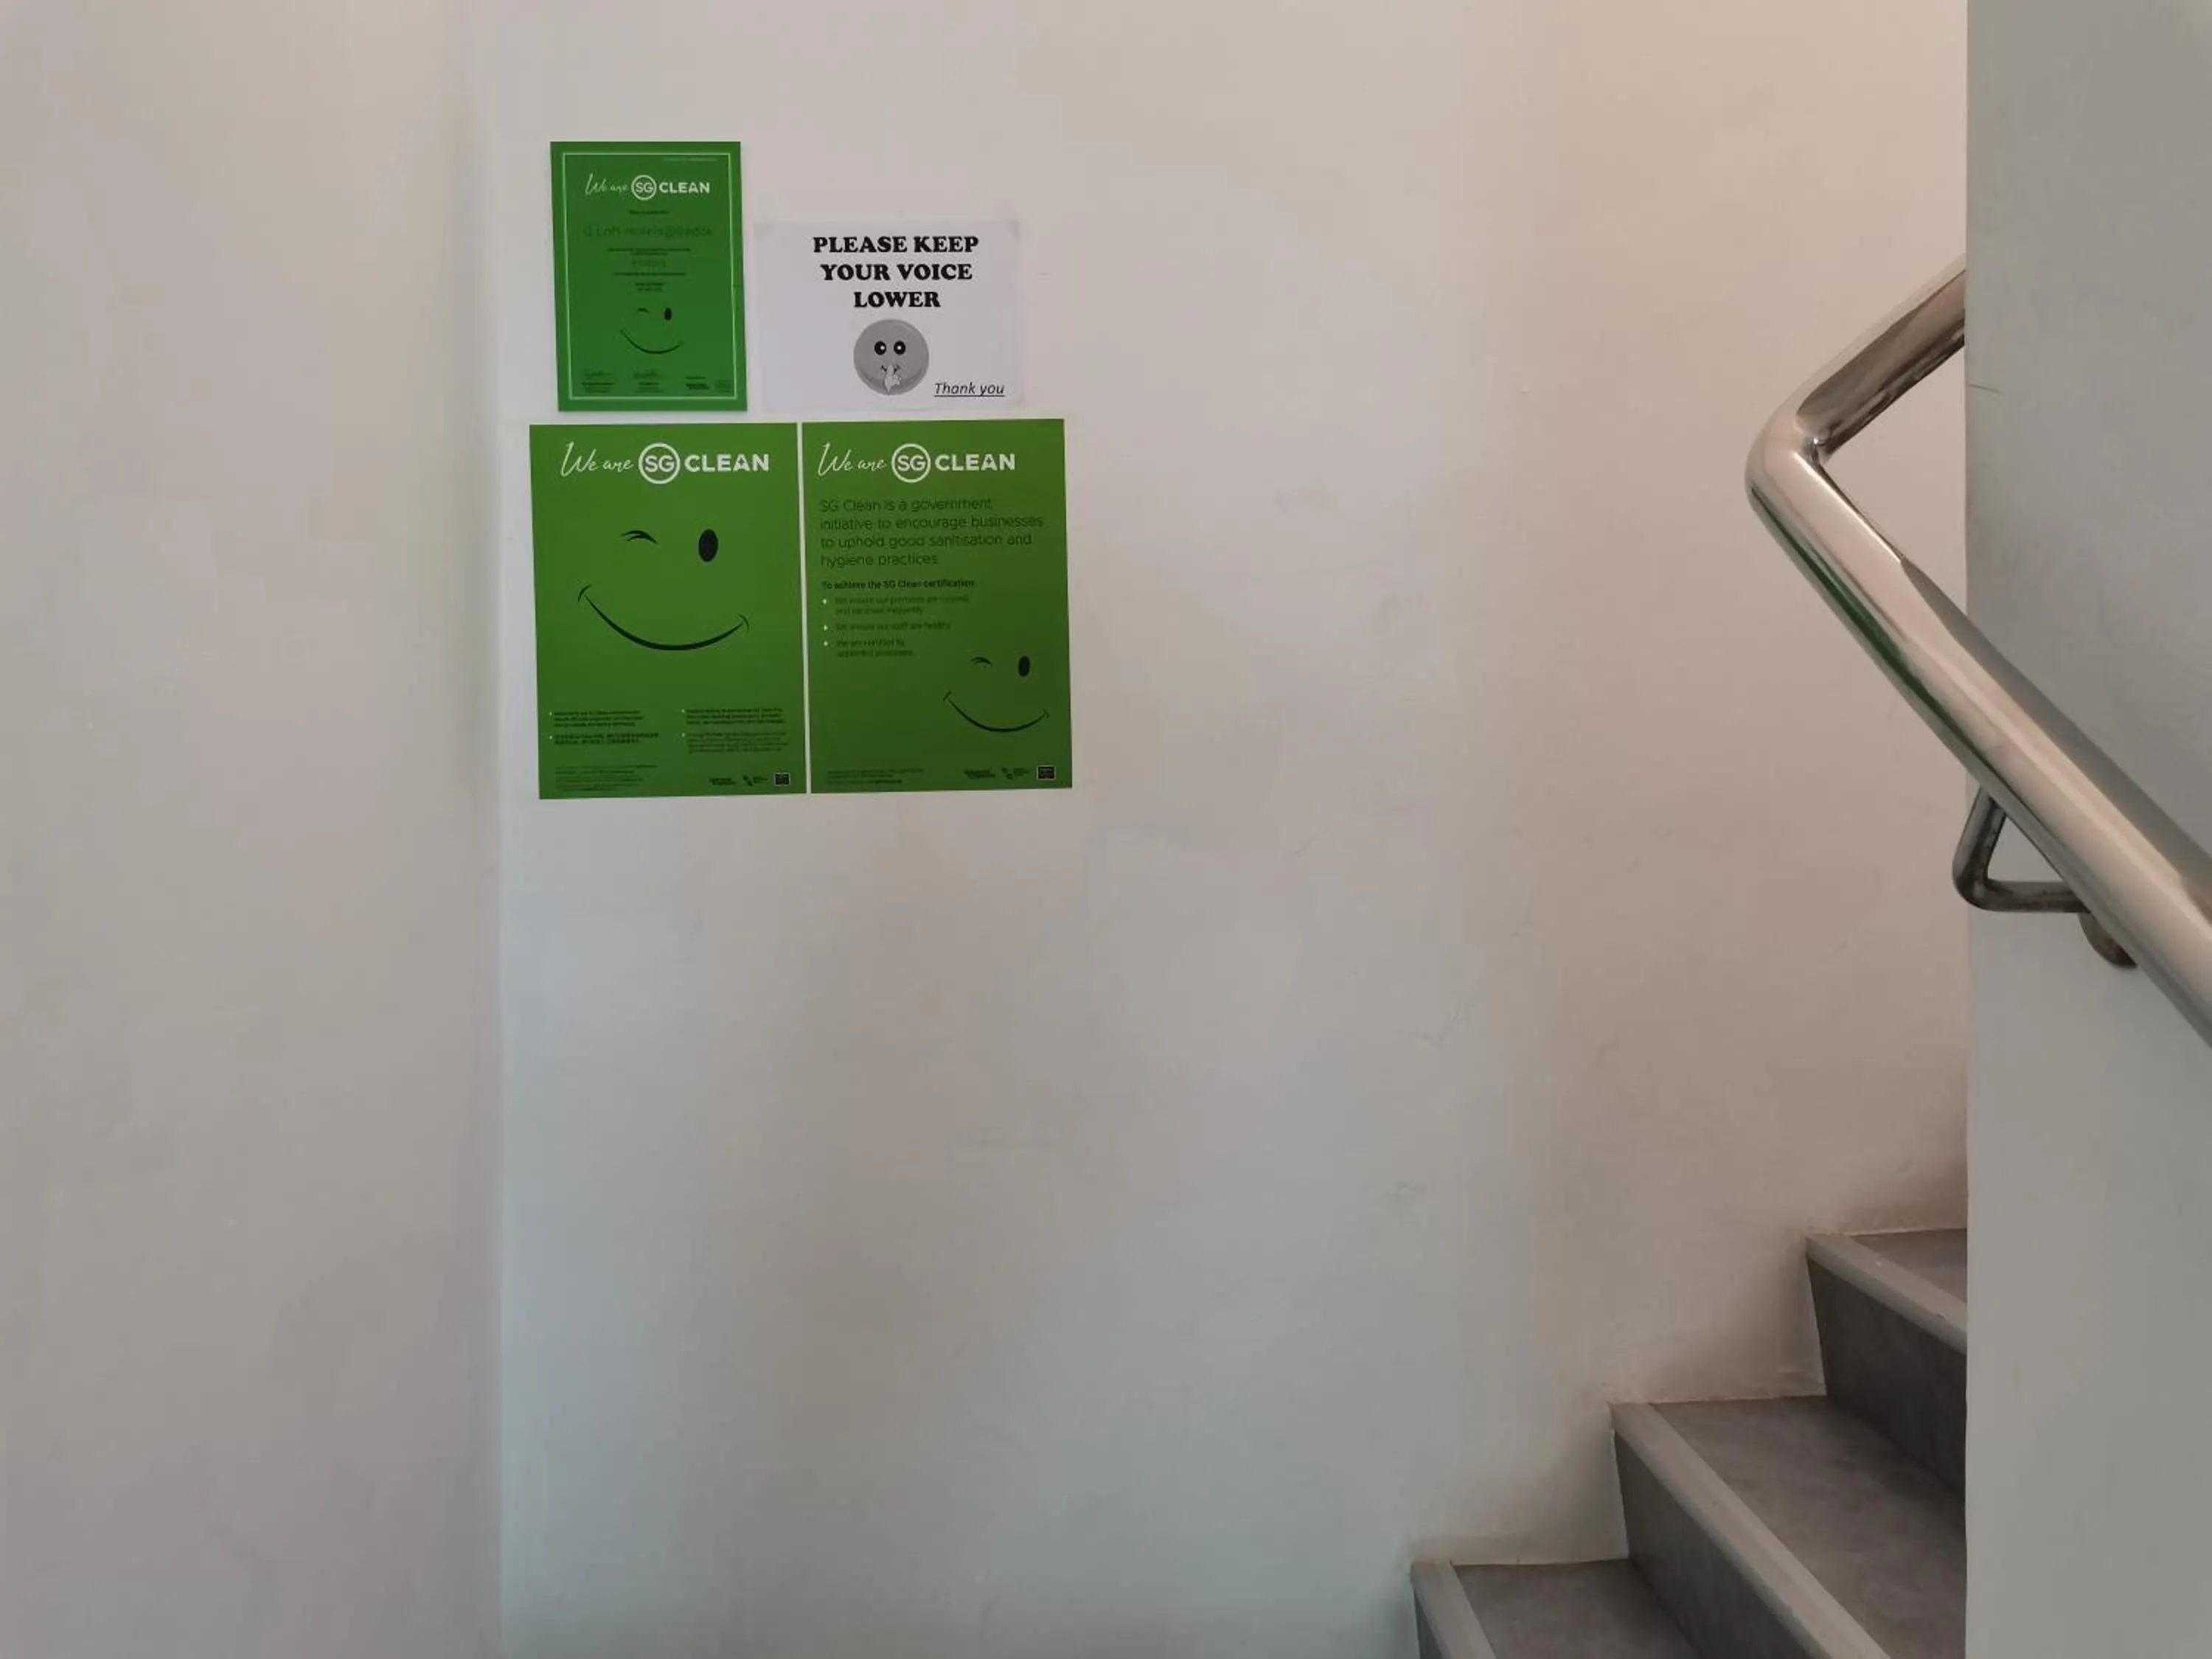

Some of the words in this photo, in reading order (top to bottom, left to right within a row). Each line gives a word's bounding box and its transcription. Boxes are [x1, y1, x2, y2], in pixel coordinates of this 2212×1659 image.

[659, 182, 710, 194] CLEAN
[813, 236, 907, 252] PLEASE
[914, 236, 979, 252] KEEP
[821, 264, 891, 281] YOUR
[897, 264, 973, 280] VOICE
[854, 292, 941, 307] LOWER
[933, 383, 976, 394] Thank
[979, 384, 1005, 397] you
[560, 441, 598, 478] We
[603, 459, 633, 473] are
[684, 453, 770, 472] CLEAN
[817, 442, 853, 477] We
[858, 458, 887, 471] are
[934, 453, 1015, 471] CLEAN
[820, 499, 839, 512] SG
[843, 499, 880, 512] Clean
[885, 499, 895, 511] is
[898, 501, 907, 510] a
[911, 498, 992, 514] government
[820, 517, 873, 531] initiative
[877, 518, 891, 529] to
[896, 519, 967, 531] encourage
[971, 515, 1044, 528] businesses
[821, 536, 835, 548] to
[839, 535, 884, 549] uphold
[888, 535, 925, 550] good
[929, 533, 1003, 548] sanitisation
[1007, 532, 1032, 546] and
[820, 554, 873, 569] hygiene
[883, 580, 896, 588] SG
